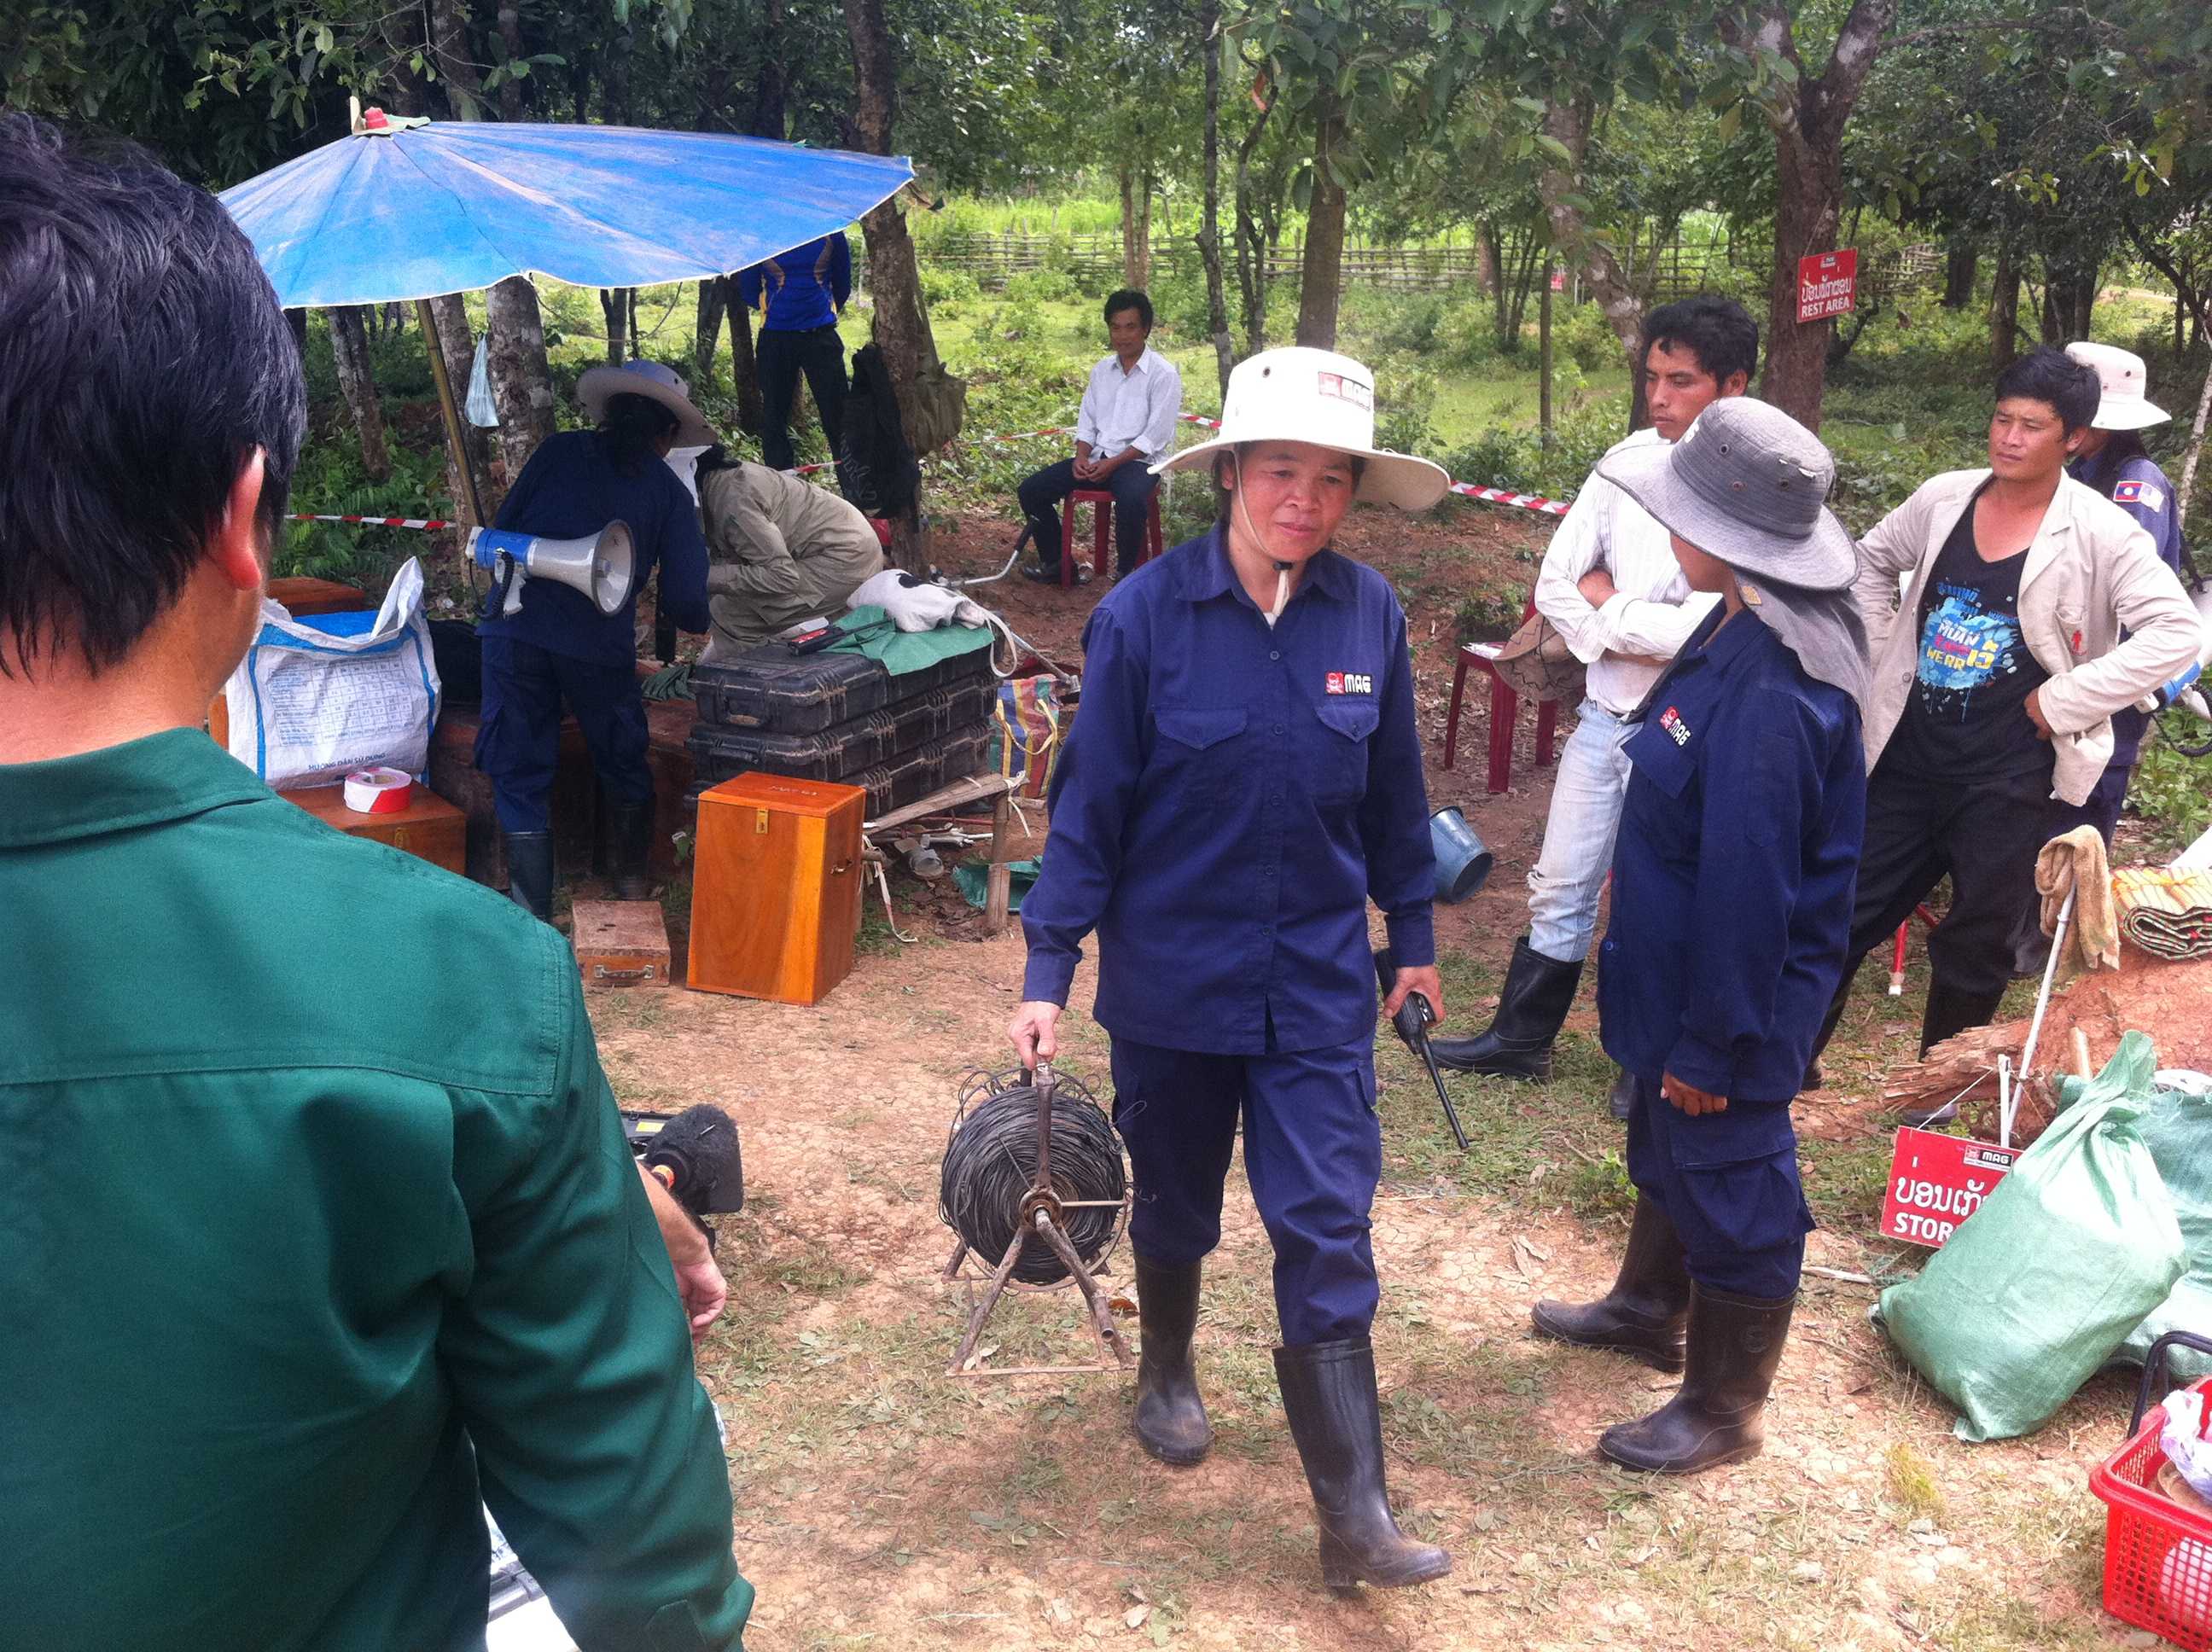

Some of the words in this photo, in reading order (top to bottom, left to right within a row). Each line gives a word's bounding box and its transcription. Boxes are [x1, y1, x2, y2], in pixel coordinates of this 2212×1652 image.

[1802, 301, 1824, 317] REST
[1825, 296, 1849, 312] AREA
[1344, 673, 1371, 693] MAG
[1668, 718, 1691, 746] MAG
[1982, 1150, 2009, 1164] MAG
